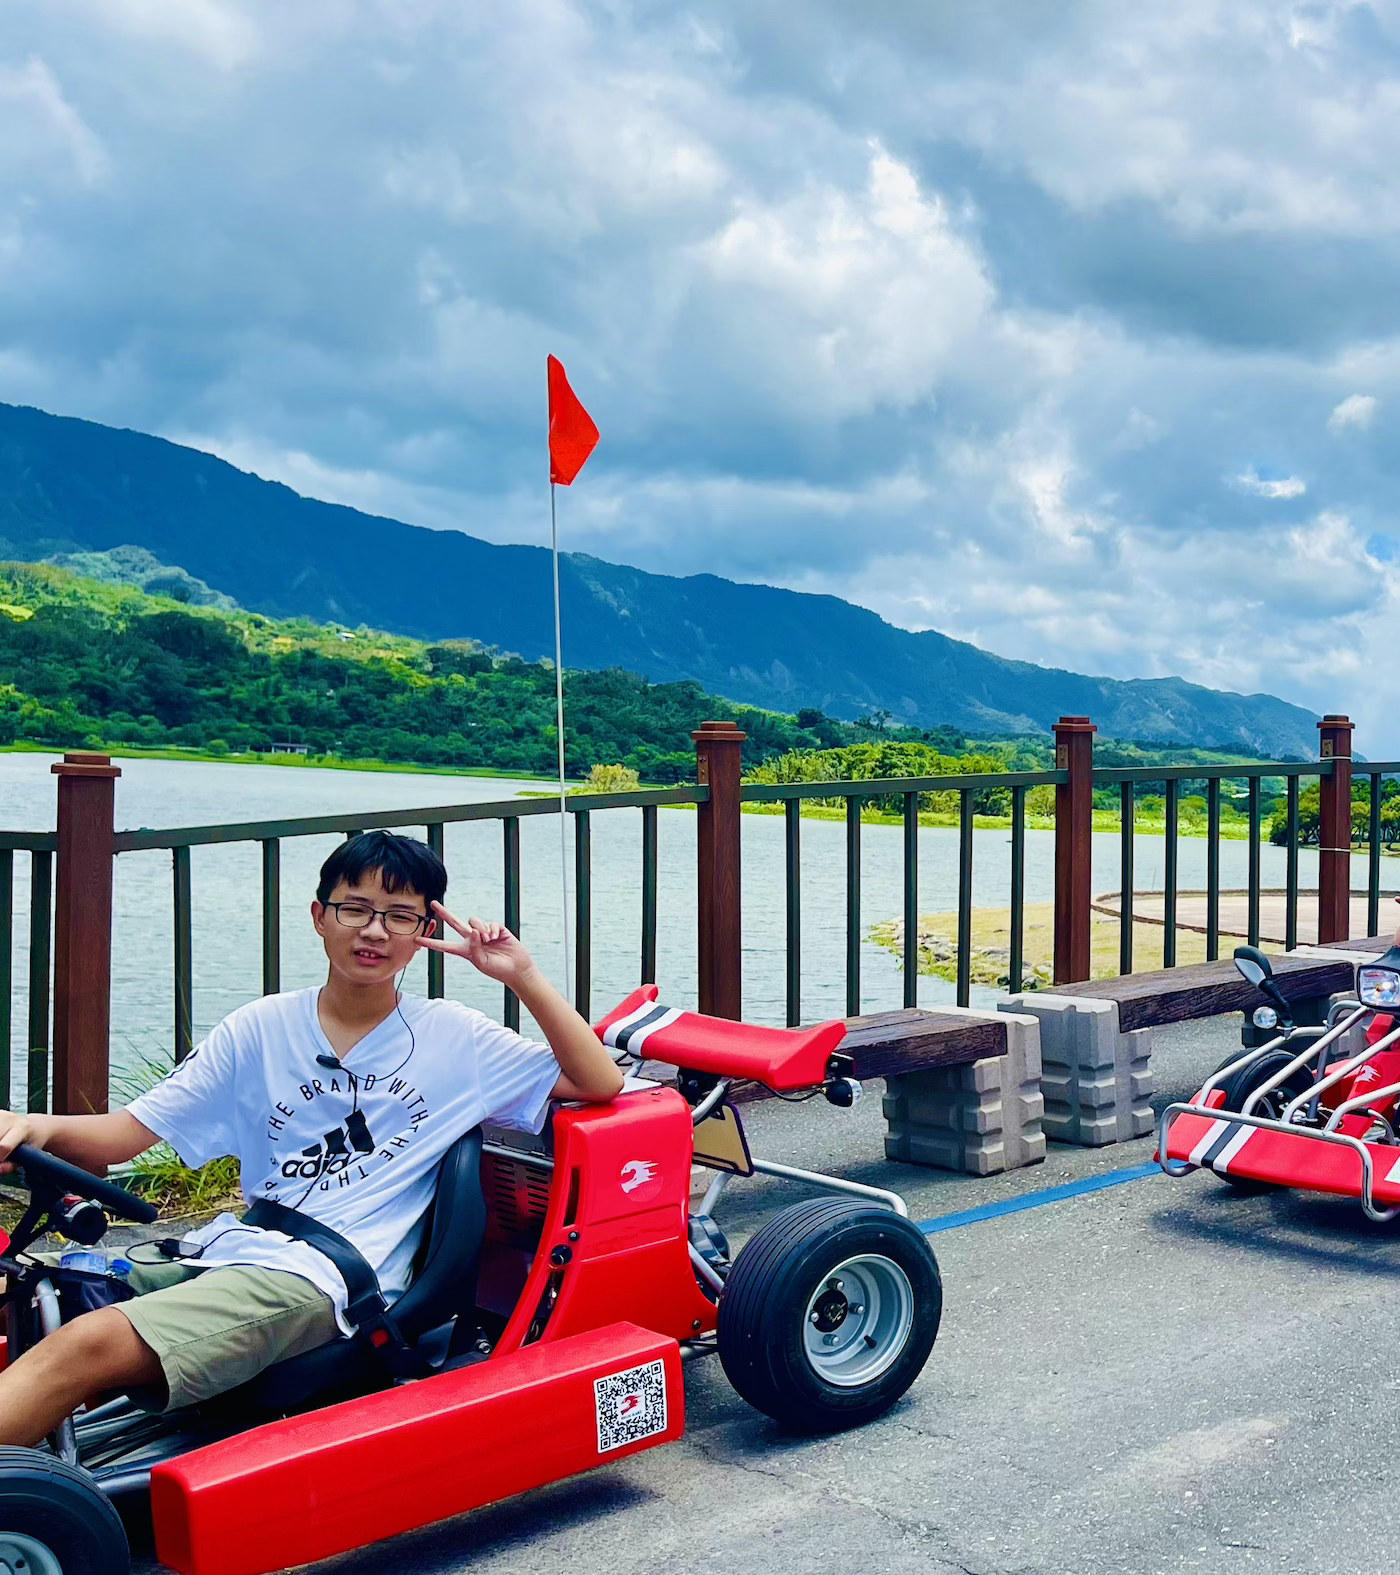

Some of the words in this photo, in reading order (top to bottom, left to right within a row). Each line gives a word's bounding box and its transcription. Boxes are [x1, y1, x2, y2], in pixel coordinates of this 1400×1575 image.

[299, 1074, 376, 1101] BRAND
[388, 1077, 429, 1124] WITH
[268, 1101, 295, 1141] THE
[379, 1124, 419, 1161] THE
